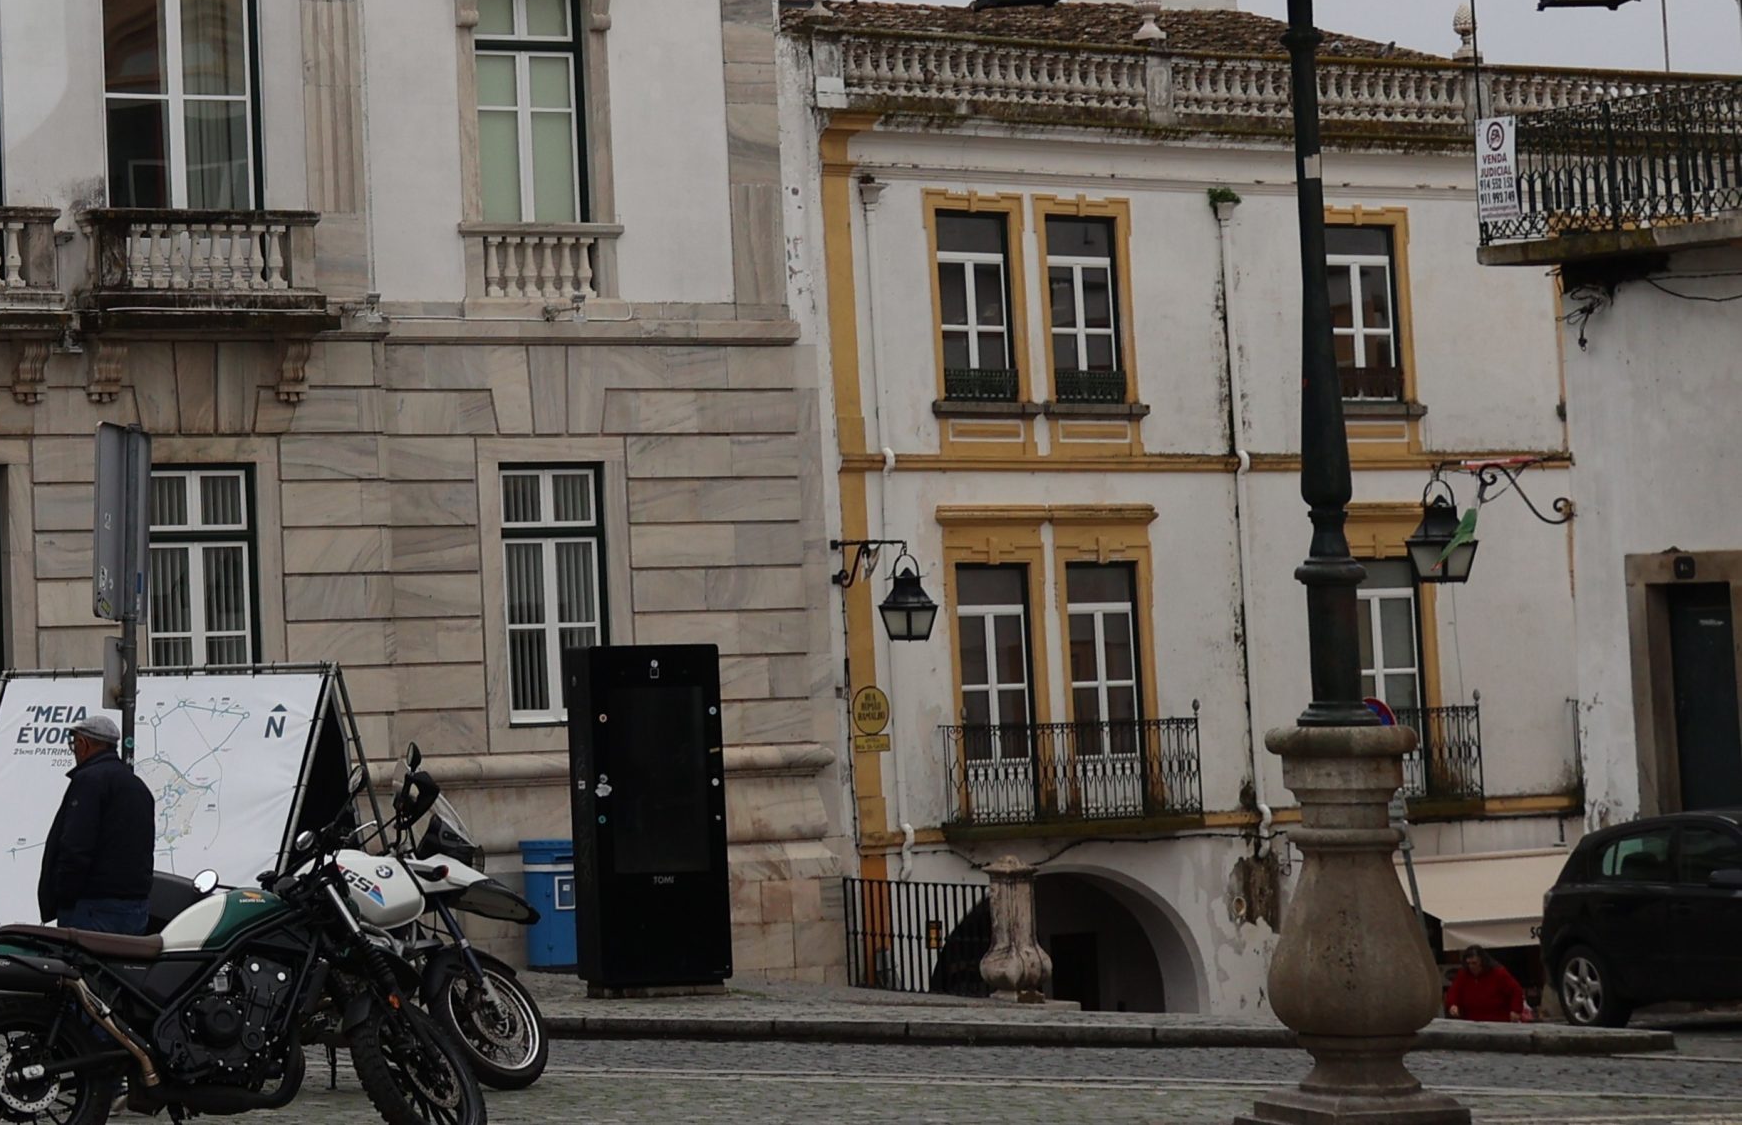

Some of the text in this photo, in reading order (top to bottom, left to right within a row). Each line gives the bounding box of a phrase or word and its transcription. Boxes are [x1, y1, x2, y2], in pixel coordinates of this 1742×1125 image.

[1482, 153, 1507, 165] VENDA
[1480, 166, 1512, 178] JUDICIAL
[1480, 193, 1491, 205] 911
[264, 715, 286, 738] N
[17, 723, 72, 744] ÉVOR
[34, 747, 75, 756] PATRIMO
[51, 758, 73, 767] 2025
[342, 869, 373, 893] GS
